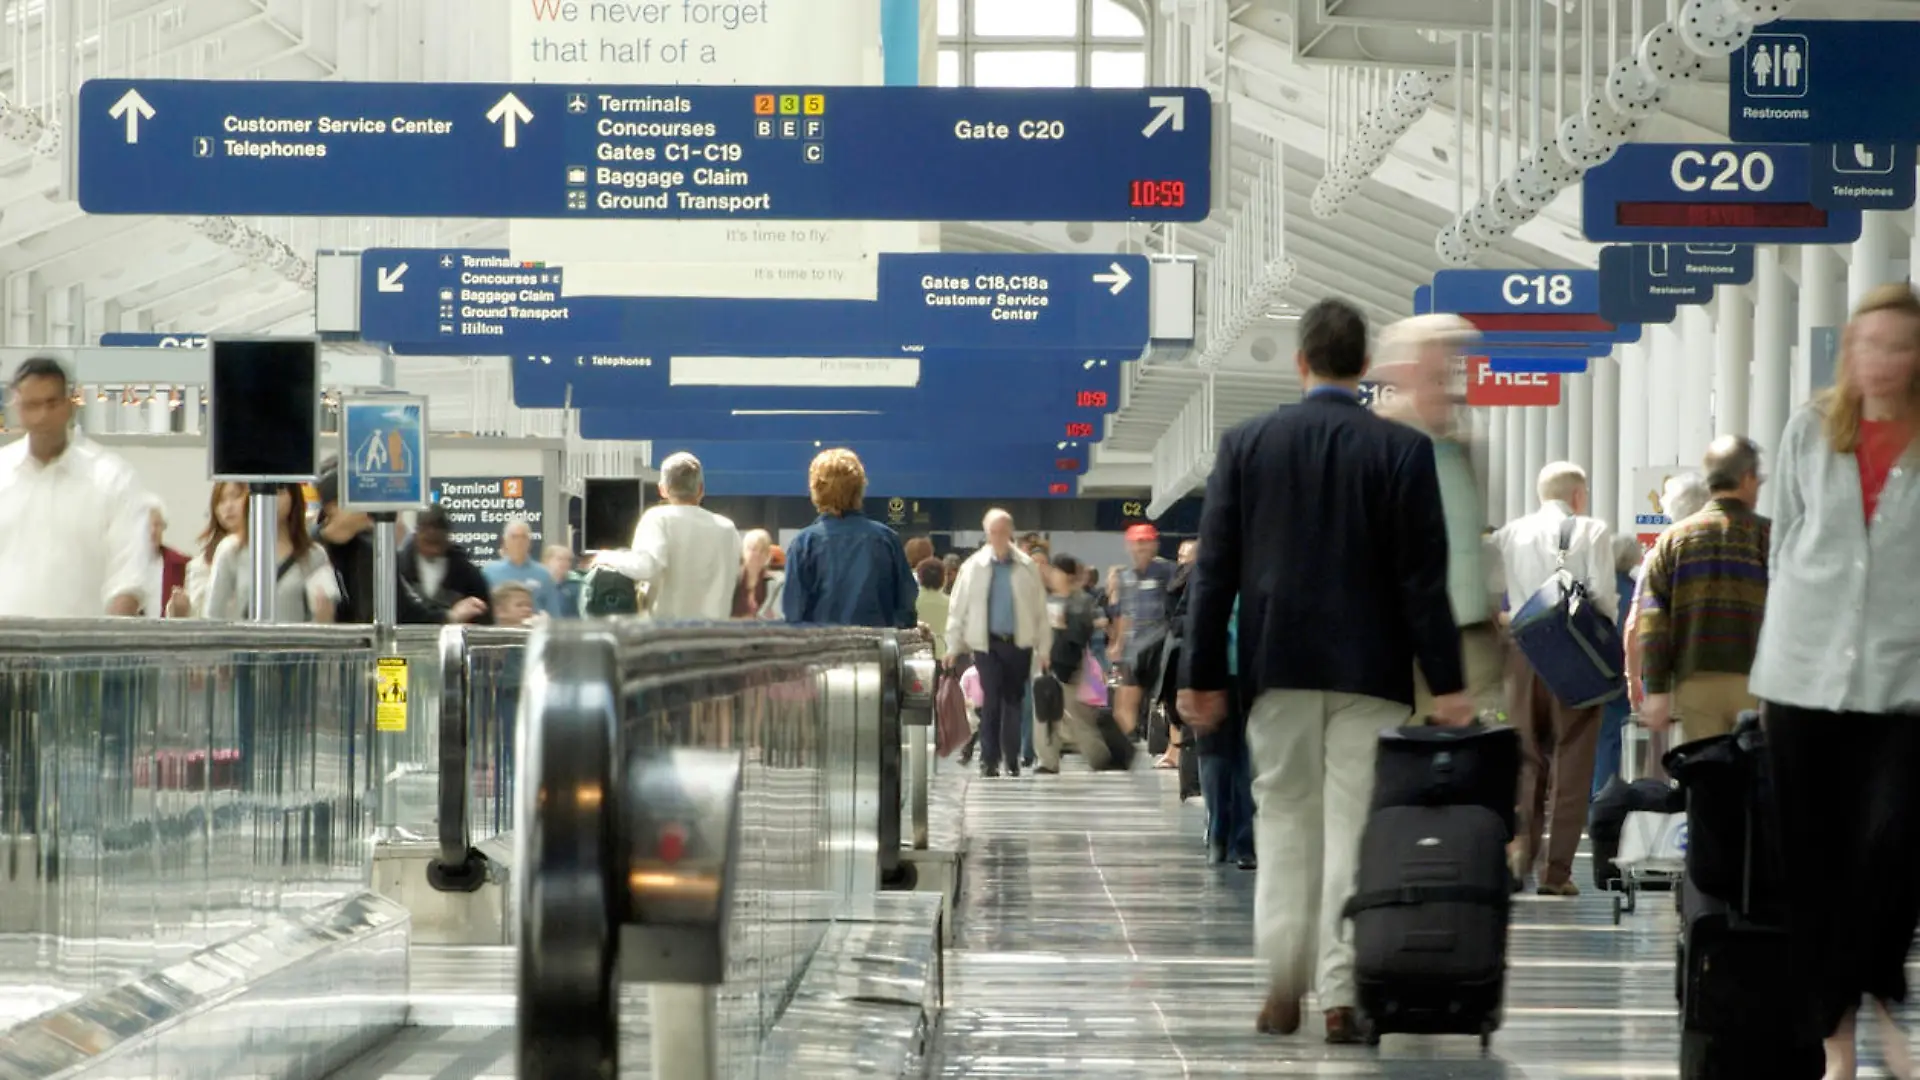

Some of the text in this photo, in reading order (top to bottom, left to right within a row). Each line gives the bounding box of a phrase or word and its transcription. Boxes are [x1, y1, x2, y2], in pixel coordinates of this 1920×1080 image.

[533, 0, 768, 30] We never forget
[532, 37, 716, 63] that half of a
[598, 95, 819, 113] Terminals 2 3 5
[1743, 107, 1809, 119] Restrooms
[223, 116, 452, 134] Customer Service Center
[597, 118, 819, 137] Concourses B E F
[954, 120, 1065, 140] Gate C20
[223, 139, 327, 158] Telephones
[597, 143, 820, 161] Gates C1-C19 C
[596, 167, 749, 188] Baggage Claim
[1670, 150, 1775, 192] C20
[1130, 181, 1185, 207] 10:59
[1832, 185, 1894, 197] Telephones
[597, 191, 770, 212] Ground Transport
[726, 229, 747, 242] It's
[752, 228, 786, 242] time
[791, 229, 806, 242] to
[754, 268, 774, 280] It's
[778, 268, 807, 280] time
[811, 268, 825, 280] to
[1685, 264, 1735, 274] Restrooms
[461, 272, 538, 284] Concourses
[921, 275, 1049, 291] Gates C18,C18a
[461, 289, 555, 303] Baggage Claim
[1502, 274, 1573, 306] C18
[1649, 286, 1696, 295] Restaurant
[925, 293, 1049, 306] Customer Service
[461, 306, 569, 320] Ground Transport
[991, 308, 1039, 320] Center
[462, 322, 504, 334] Hilton
[592, 355, 652, 367] Telephones
[441, 480, 518, 495] Terminal 2
[440, 496, 525, 509] Concourse
[446, 511, 476, 522] own
[448, 532, 498, 543] aggage
